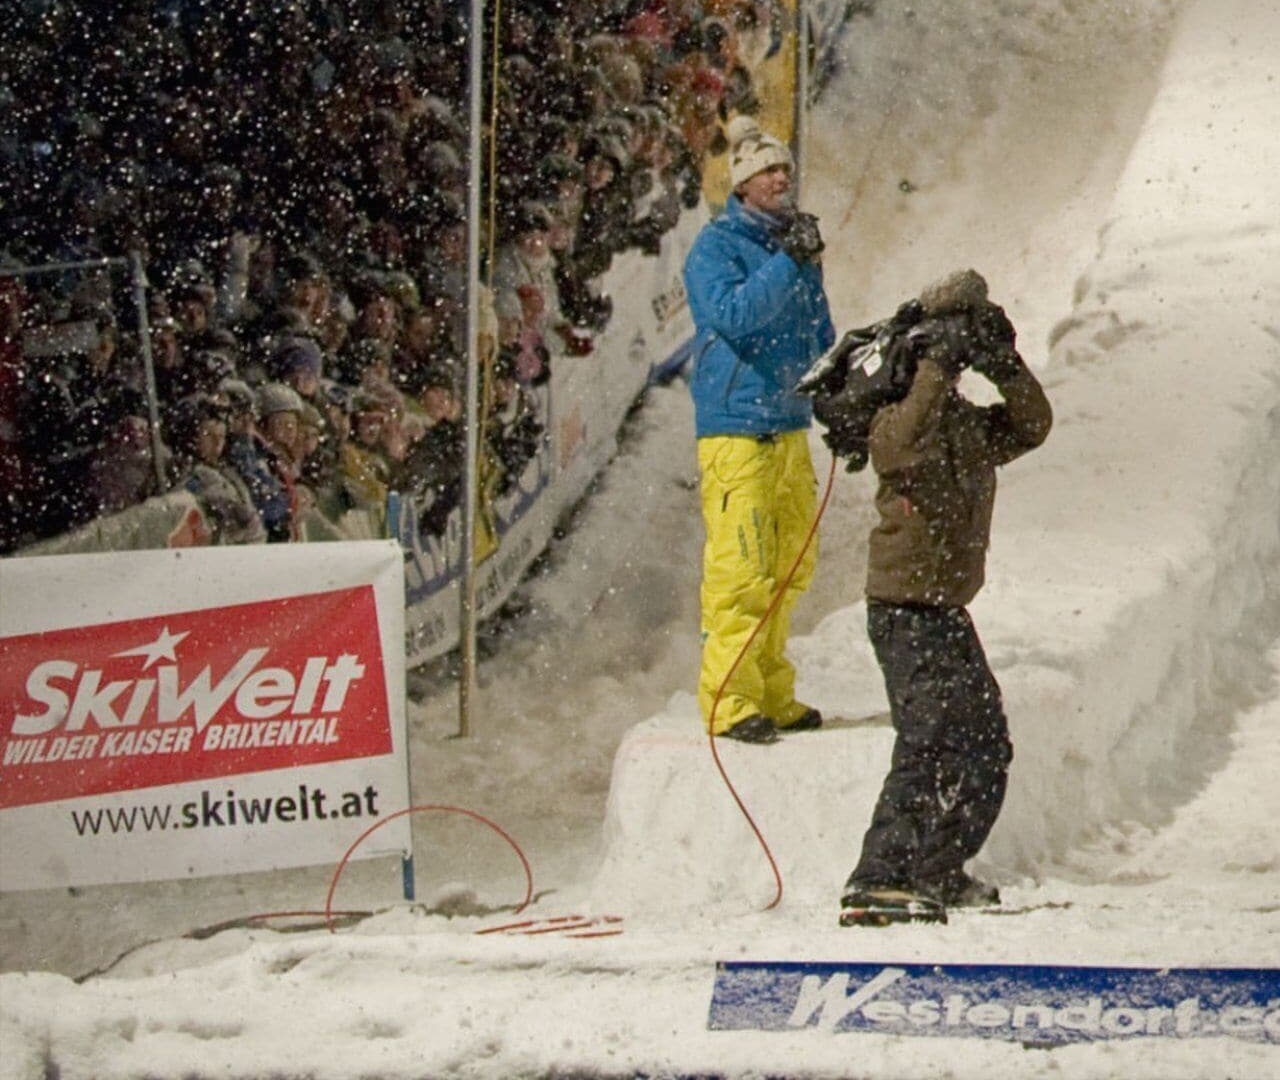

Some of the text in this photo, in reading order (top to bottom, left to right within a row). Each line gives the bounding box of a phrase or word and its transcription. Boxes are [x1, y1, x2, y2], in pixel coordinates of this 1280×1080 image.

[11, 646, 366, 735] SkiWelt
[3, 718, 340, 766] WILDER KAISER BRIXENTAL
[72, 784, 380, 836] www.skiwelt.at
